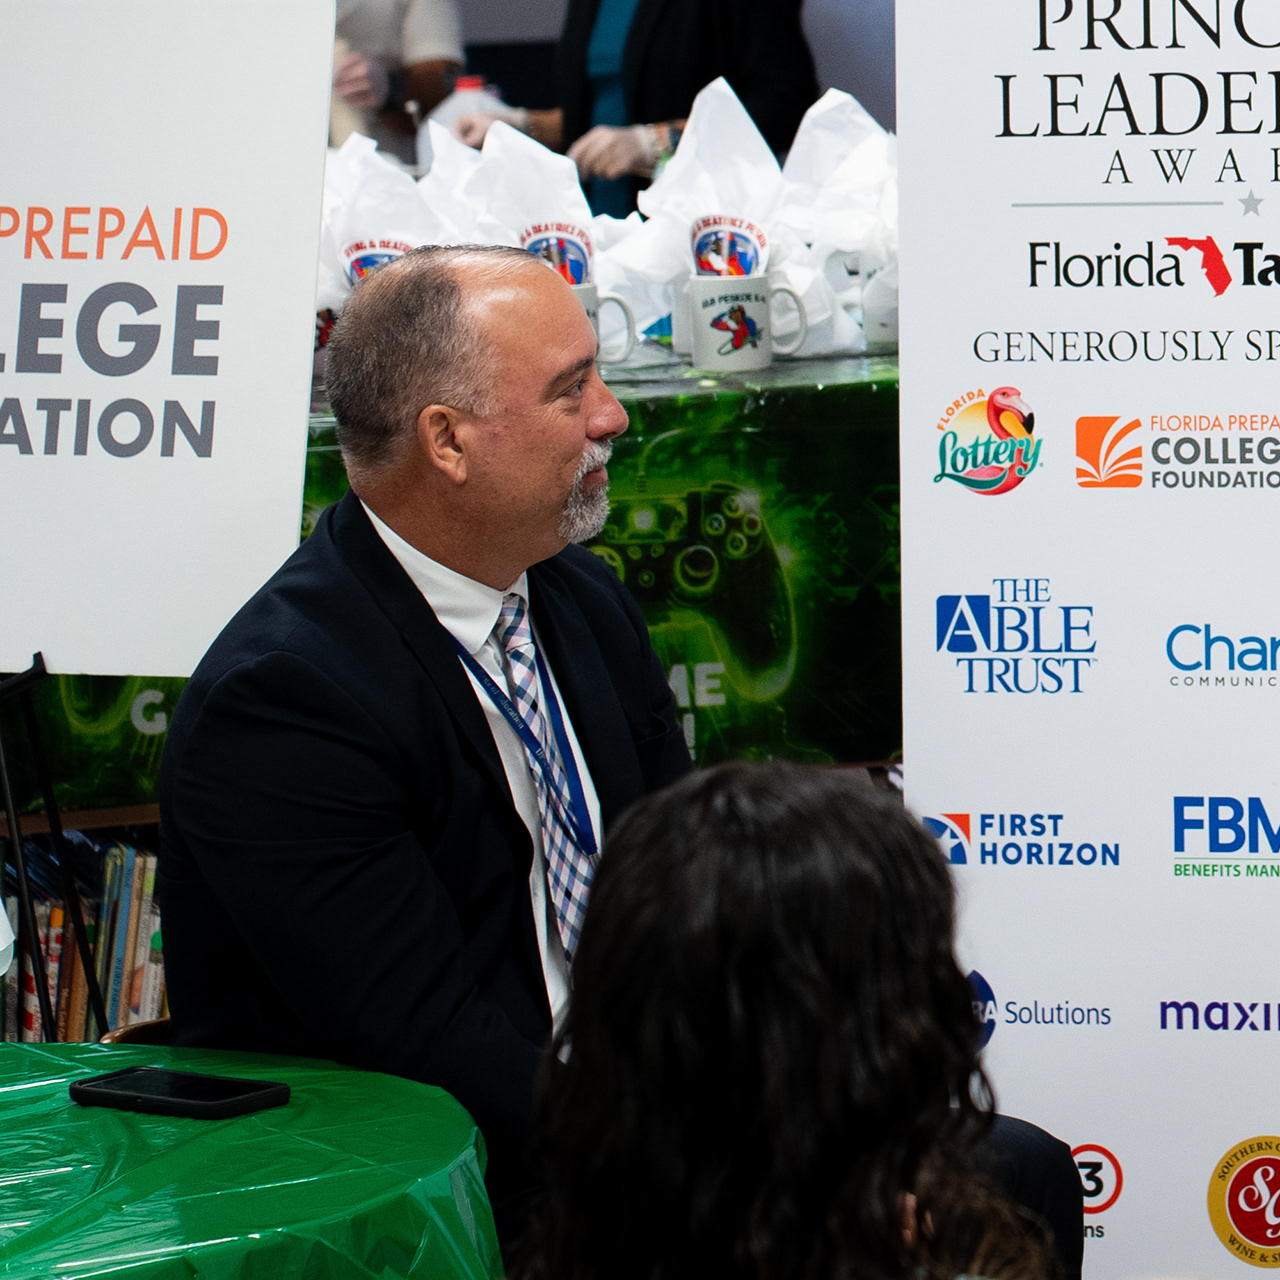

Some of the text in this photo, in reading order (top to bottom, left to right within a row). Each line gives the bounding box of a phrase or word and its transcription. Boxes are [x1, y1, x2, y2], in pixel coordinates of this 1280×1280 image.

[1028, 242, 1185, 288] Florida
[0, 282, 225, 377] EGE
[973, 330, 1235, 363] GENEROUSLY
[936, 388, 986, 431] FLORIDA
[1151, 415, 1224, 431] FLORIDA
[933, 431, 1043, 490] Lottery
[992, 578, 1052, 603] THE
[937, 595, 1097, 653] ABLE
[956, 657, 1090, 694] TRUST
[499, 694, 524, 730] Education
[980, 814, 1064, 838] FIRST
[980, 842, 1120, 867] HORIZON
[1173, 864, 1241, 878] BENEFITS
[1005, 1000, 1111, 1026] Solutions
[1218, 1141, 1274, 1181] SOUTHERN
[1084, 1225, 1105, 1238] ns
[1228, 1234, 1257, 1260] WINE
[1259, 1253, 1269, 1263] &
